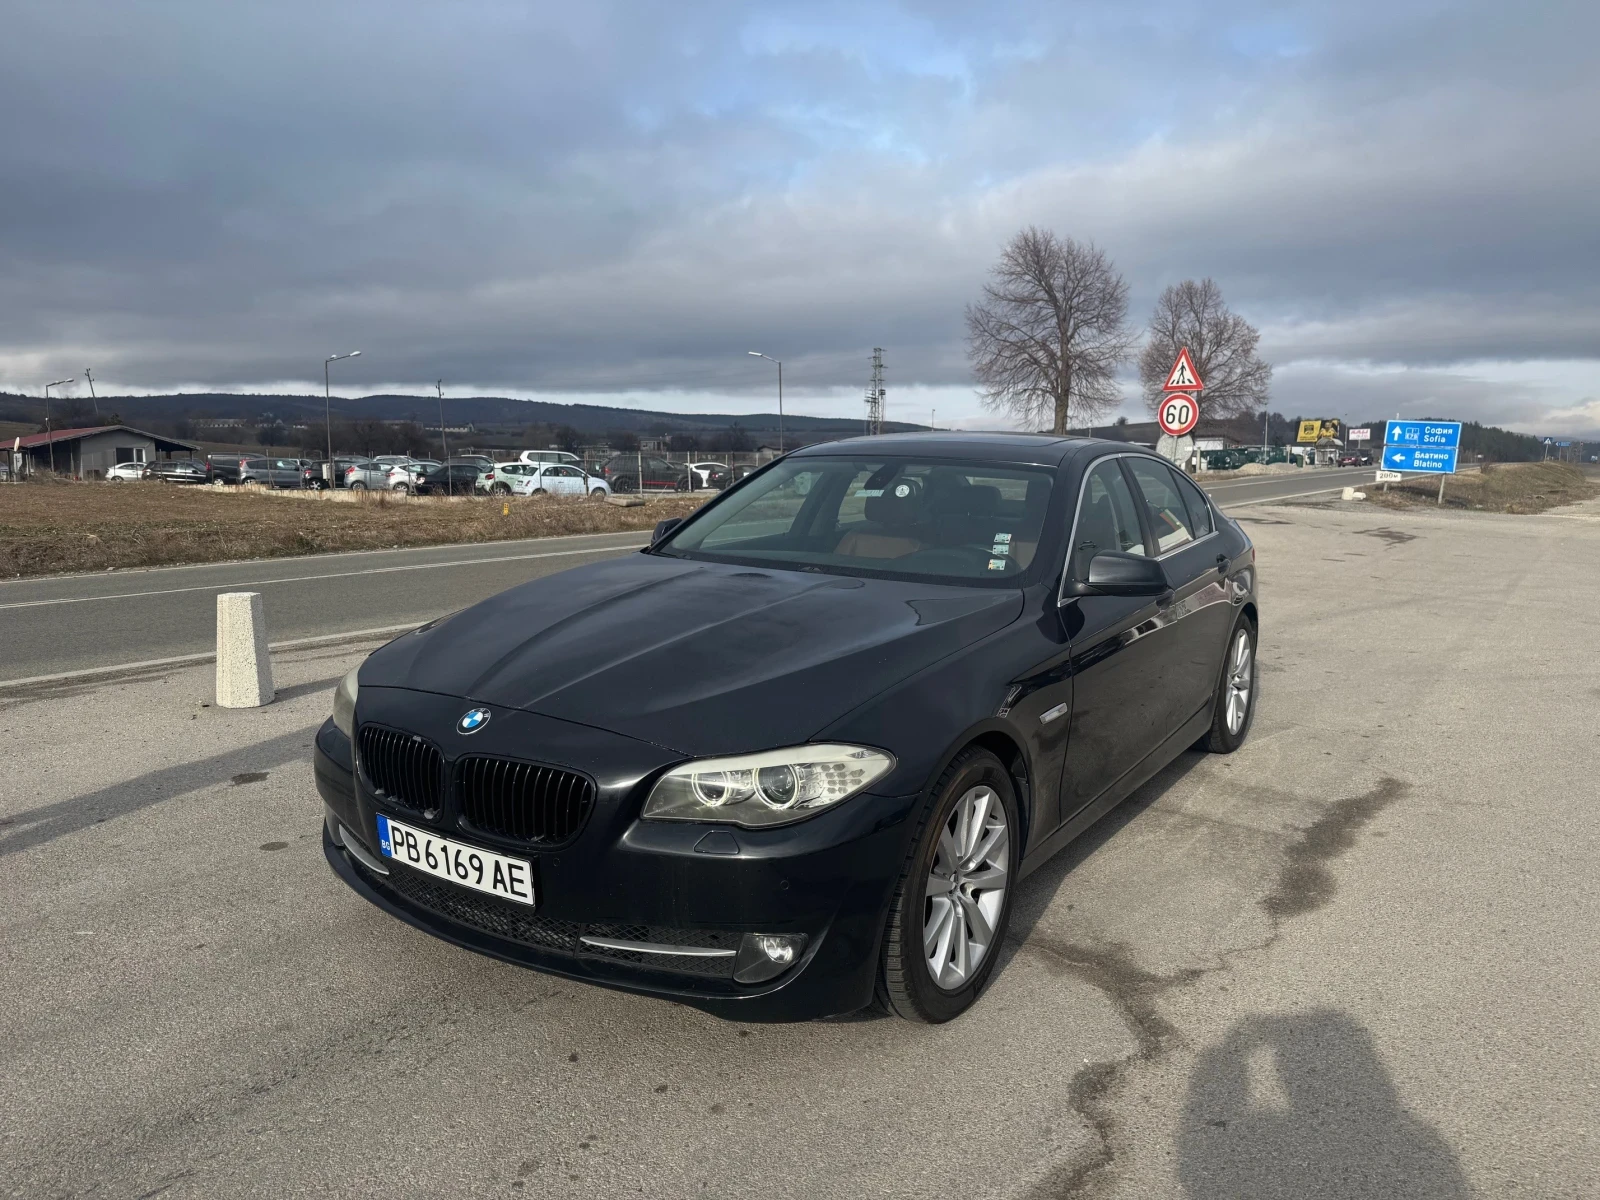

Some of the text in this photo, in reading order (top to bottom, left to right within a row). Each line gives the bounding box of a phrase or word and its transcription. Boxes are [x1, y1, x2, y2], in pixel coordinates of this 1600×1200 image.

[1166, 404, 1190, 425] 60
[1424, 426, 1453, 435] София
[1423, 435, 1446, 443] Sofia
[1414, 451, 1449, 460] Блатино
[1413, 460, 1443, 468] Blatino
[391, 825, 528, 898] PB 6169 AE
